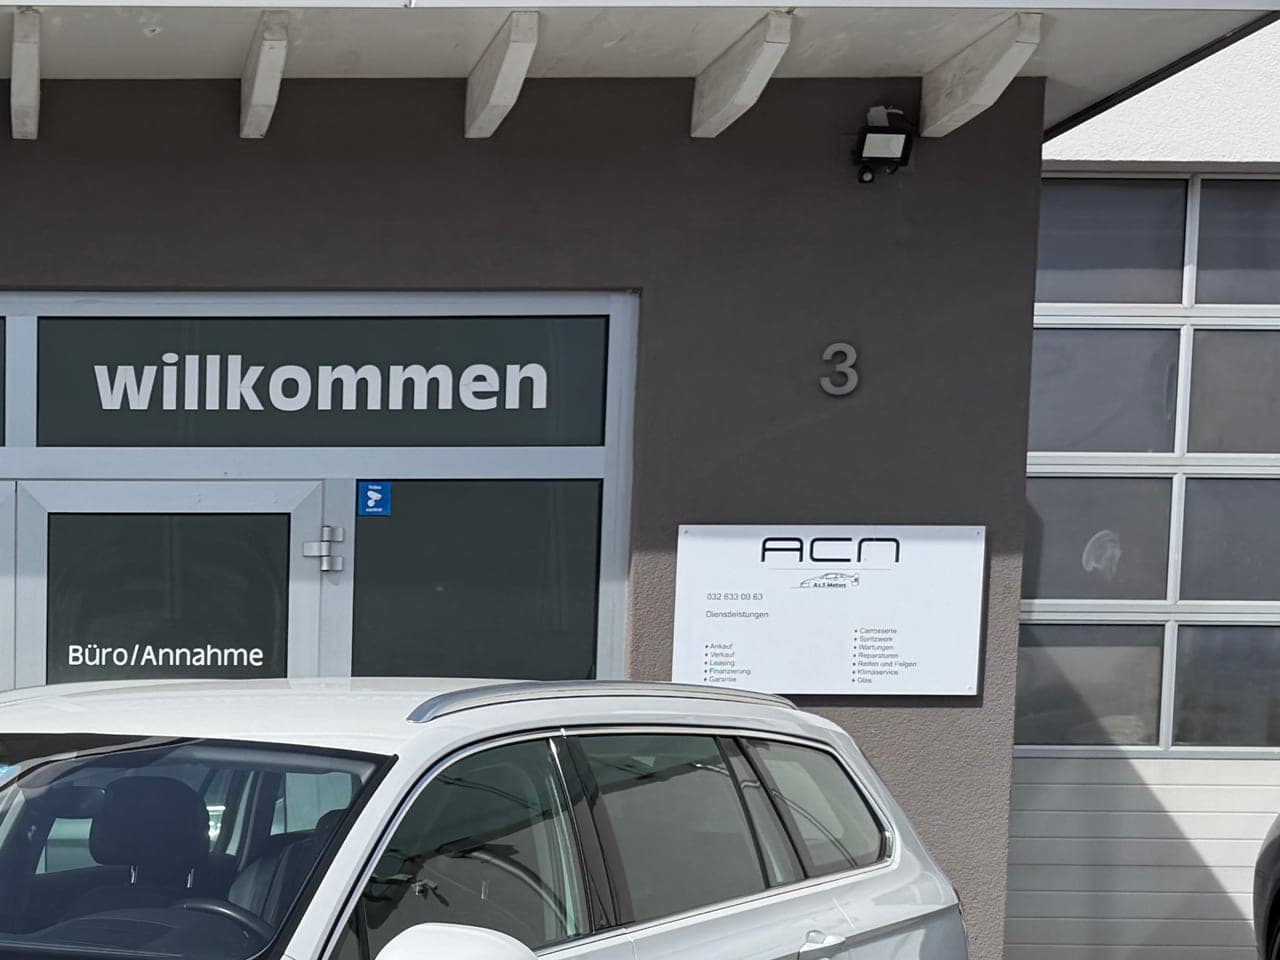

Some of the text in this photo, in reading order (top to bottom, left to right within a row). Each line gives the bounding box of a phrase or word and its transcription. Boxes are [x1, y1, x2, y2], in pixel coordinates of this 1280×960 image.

[820, 342, 858, 396] 3
[94, 352, 548, 412] willkommen
[705, 610, 769, 619] Dienstleistungen
[68, 644, 264, 666] Büro/Annahme
[709, 659, 735, 667] Leasing
[709, 667, 751, 675] Finanzierung
